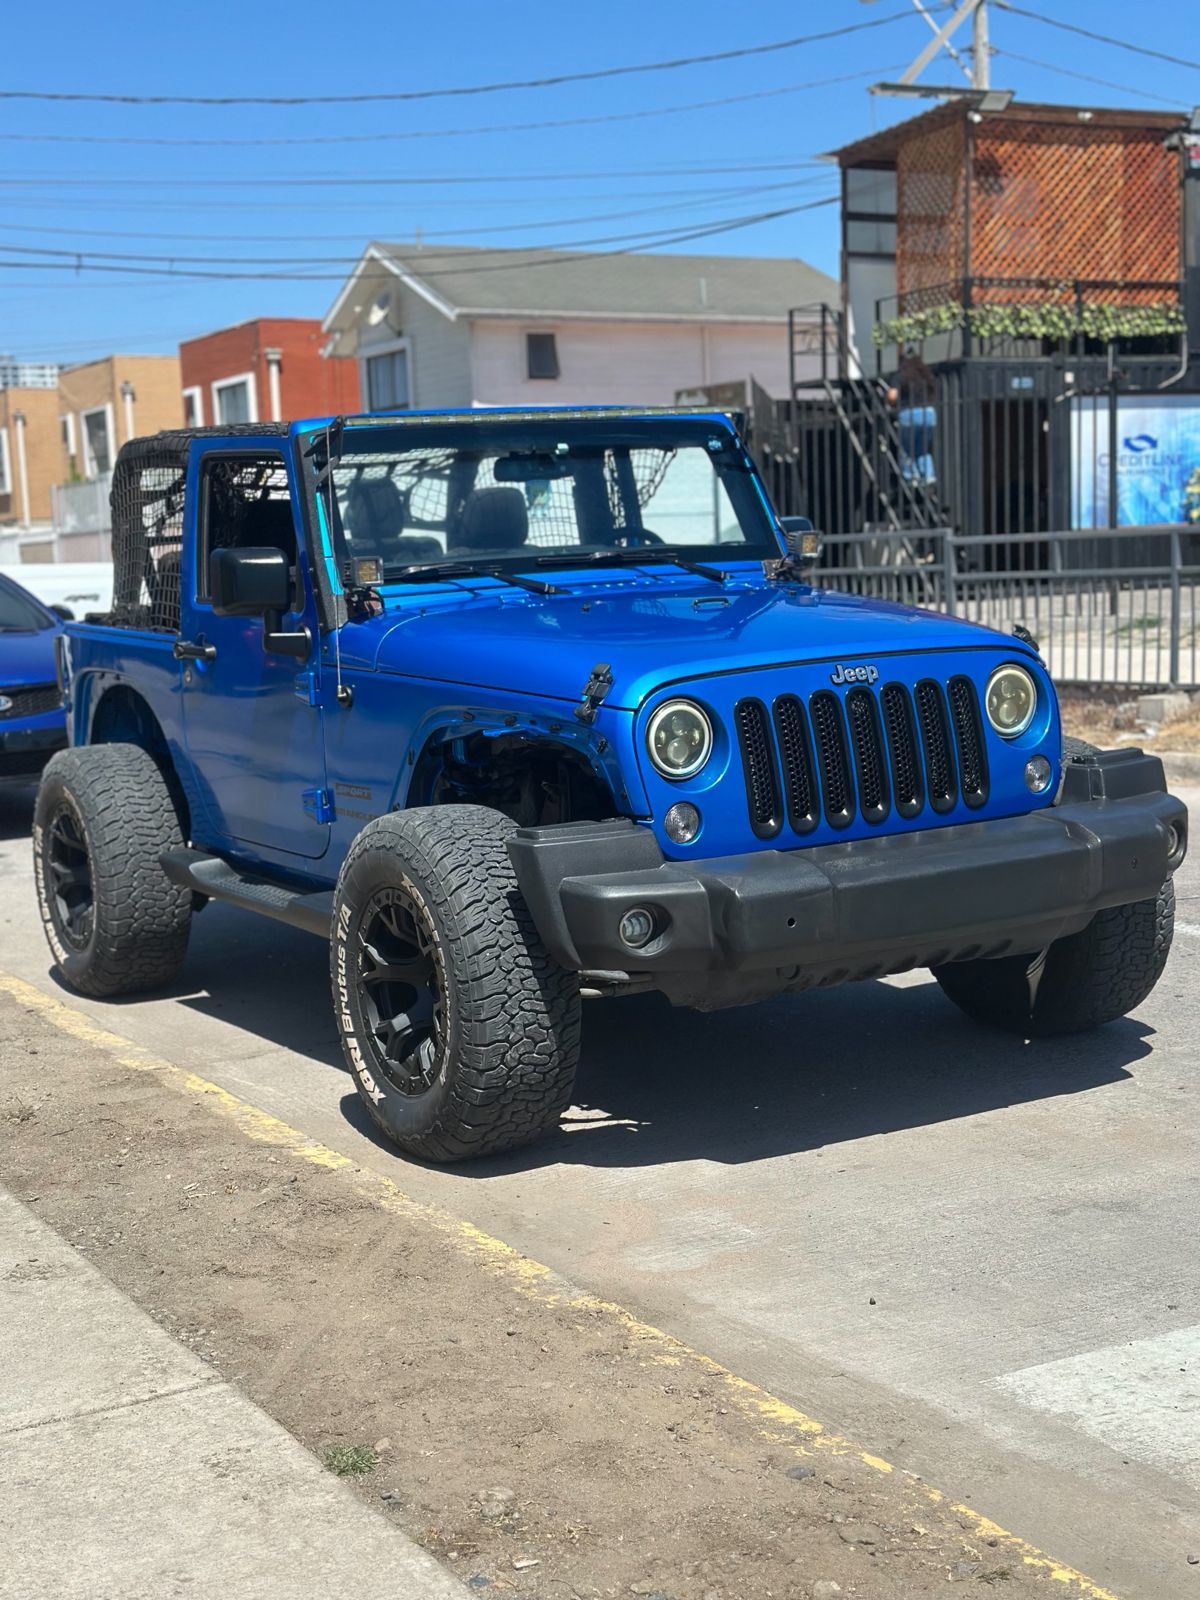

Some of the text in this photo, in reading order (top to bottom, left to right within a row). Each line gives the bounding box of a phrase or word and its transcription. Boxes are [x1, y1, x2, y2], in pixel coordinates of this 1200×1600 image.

[1098, 453, 1185, 468] CEDITLINE
[831, 664, 879, 685] Jeep
[337, 903, 387, 1107] XBRI Brutus T/A
